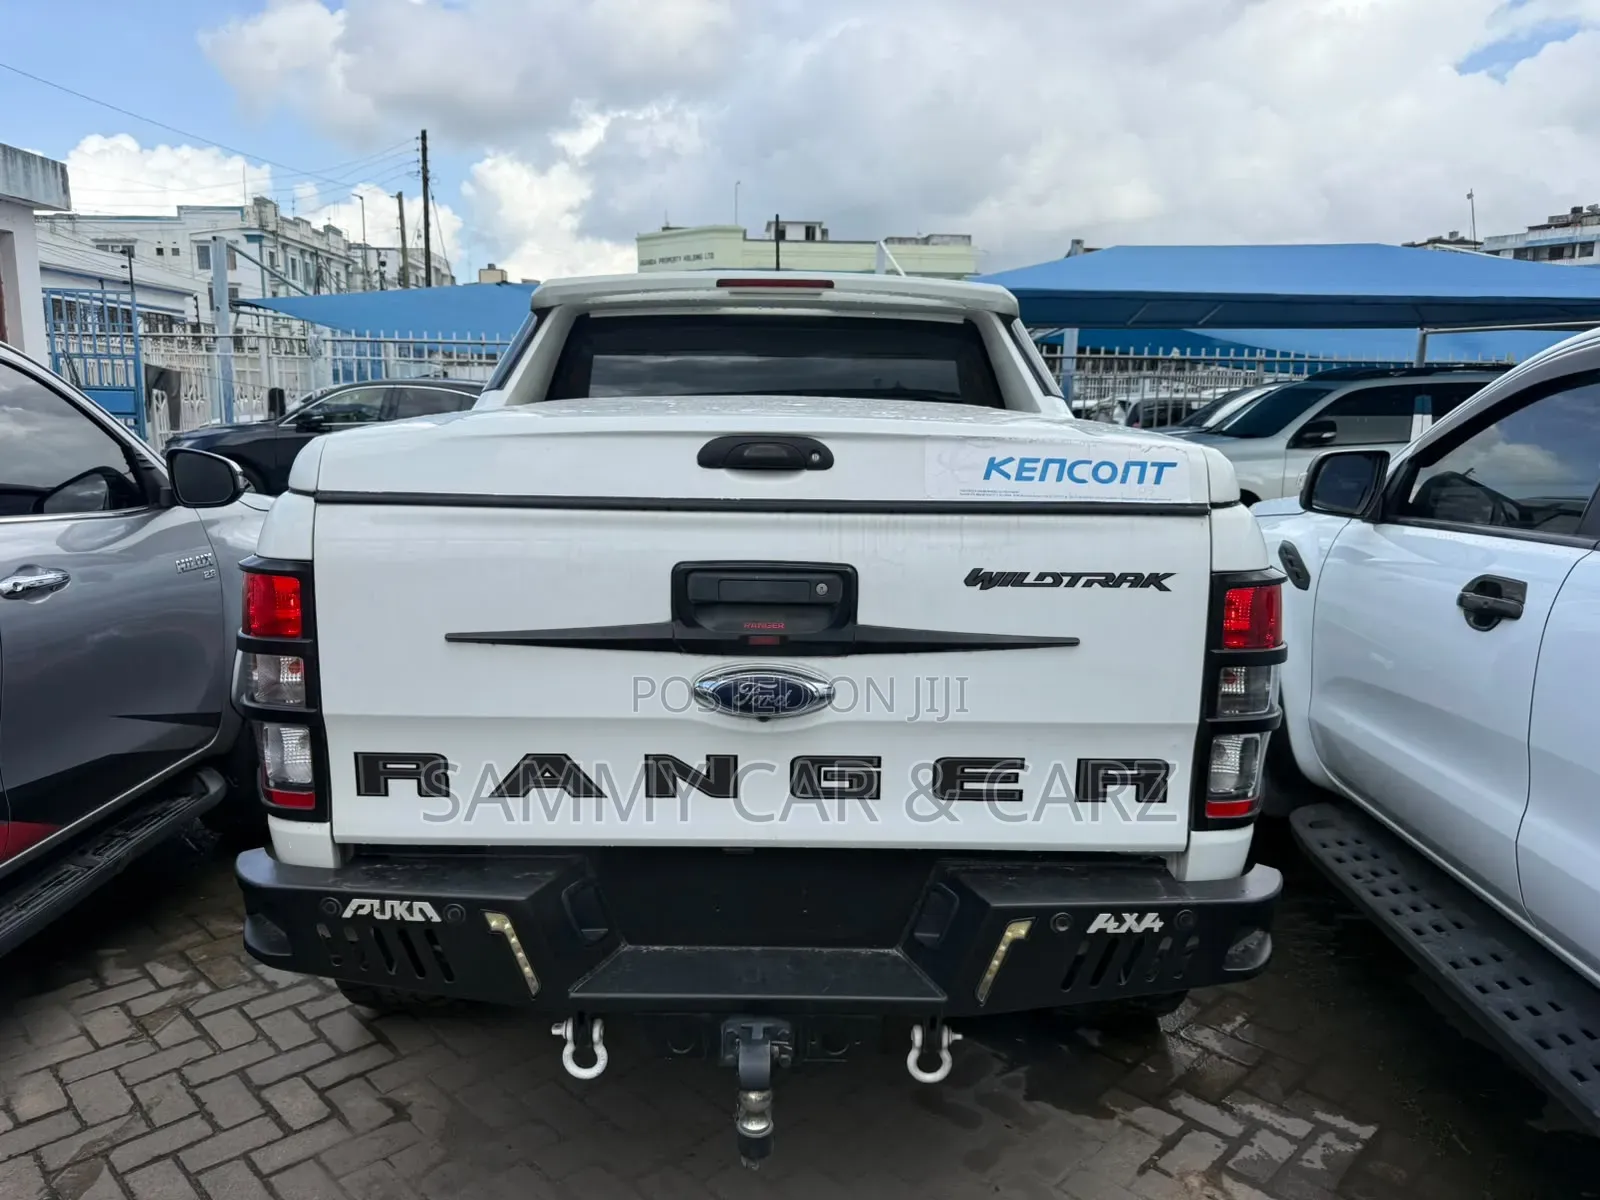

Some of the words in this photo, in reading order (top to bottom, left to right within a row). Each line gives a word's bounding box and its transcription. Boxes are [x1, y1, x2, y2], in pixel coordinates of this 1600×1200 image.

[704, 252, 714, 260] LTD
[963, 567, 1179, 592] WILDTRAK
[732, 682, 793, 708] Ford
[353, 751, 1170, 803] RANGER
[341, 898, 442, 923] PUKA
